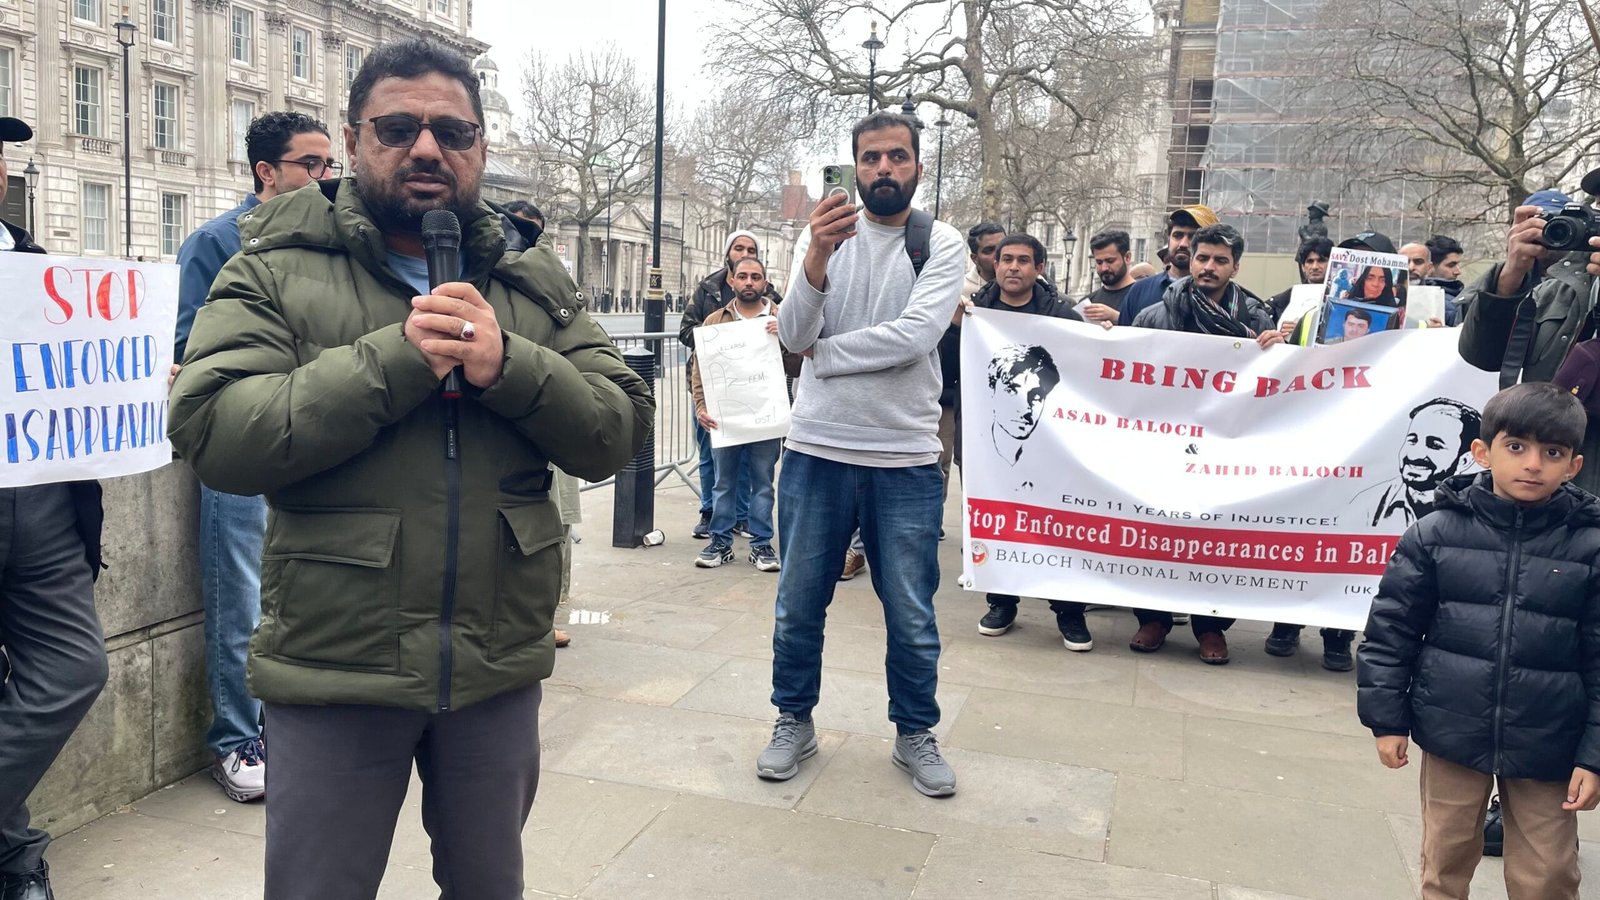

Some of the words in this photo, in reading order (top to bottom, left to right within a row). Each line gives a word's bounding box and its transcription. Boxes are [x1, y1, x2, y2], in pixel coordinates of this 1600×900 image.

[1349, 254, 1368, 264] Dost
[43, 265, 146, 324] STOP
[12, 334, 157, 392] ENFORCED
[1100, 357, 1237, 393] BRING
[1254, 365, 1372, 398] BACK
[5, 400, 169, 463] ISAPPEARANC
[1053, 407, 1107, 426] ASAD
[1116, 417, 1205, 438] BALOCH
[1185, 443, 1199, 455] &
[1185, 463, 1257, 477] ZAHID
[1269, 465, 1364, 478] BALOCH
[1062, 494, 1097, 507] END
[1107, 501, 1122, 511] 11
[1133, 504, 1192, 520] YEARS
[1231, 512, 1340, 527] INJUSTICE!
[1014, 509, 1111, 545] Enforced
[1120, 525, 1305, 562] Disappearances
[1314, 540, 1338, 563] in
[1348, 541, 1396, 565] Bal
[996, 548, 1072, 569] BALOCH
[1081, 558, 1179, 580] NATIONAL
[1188, 571, 1309, 592] MOVEMENT
[1344, 584, 1372, 595] (UK
